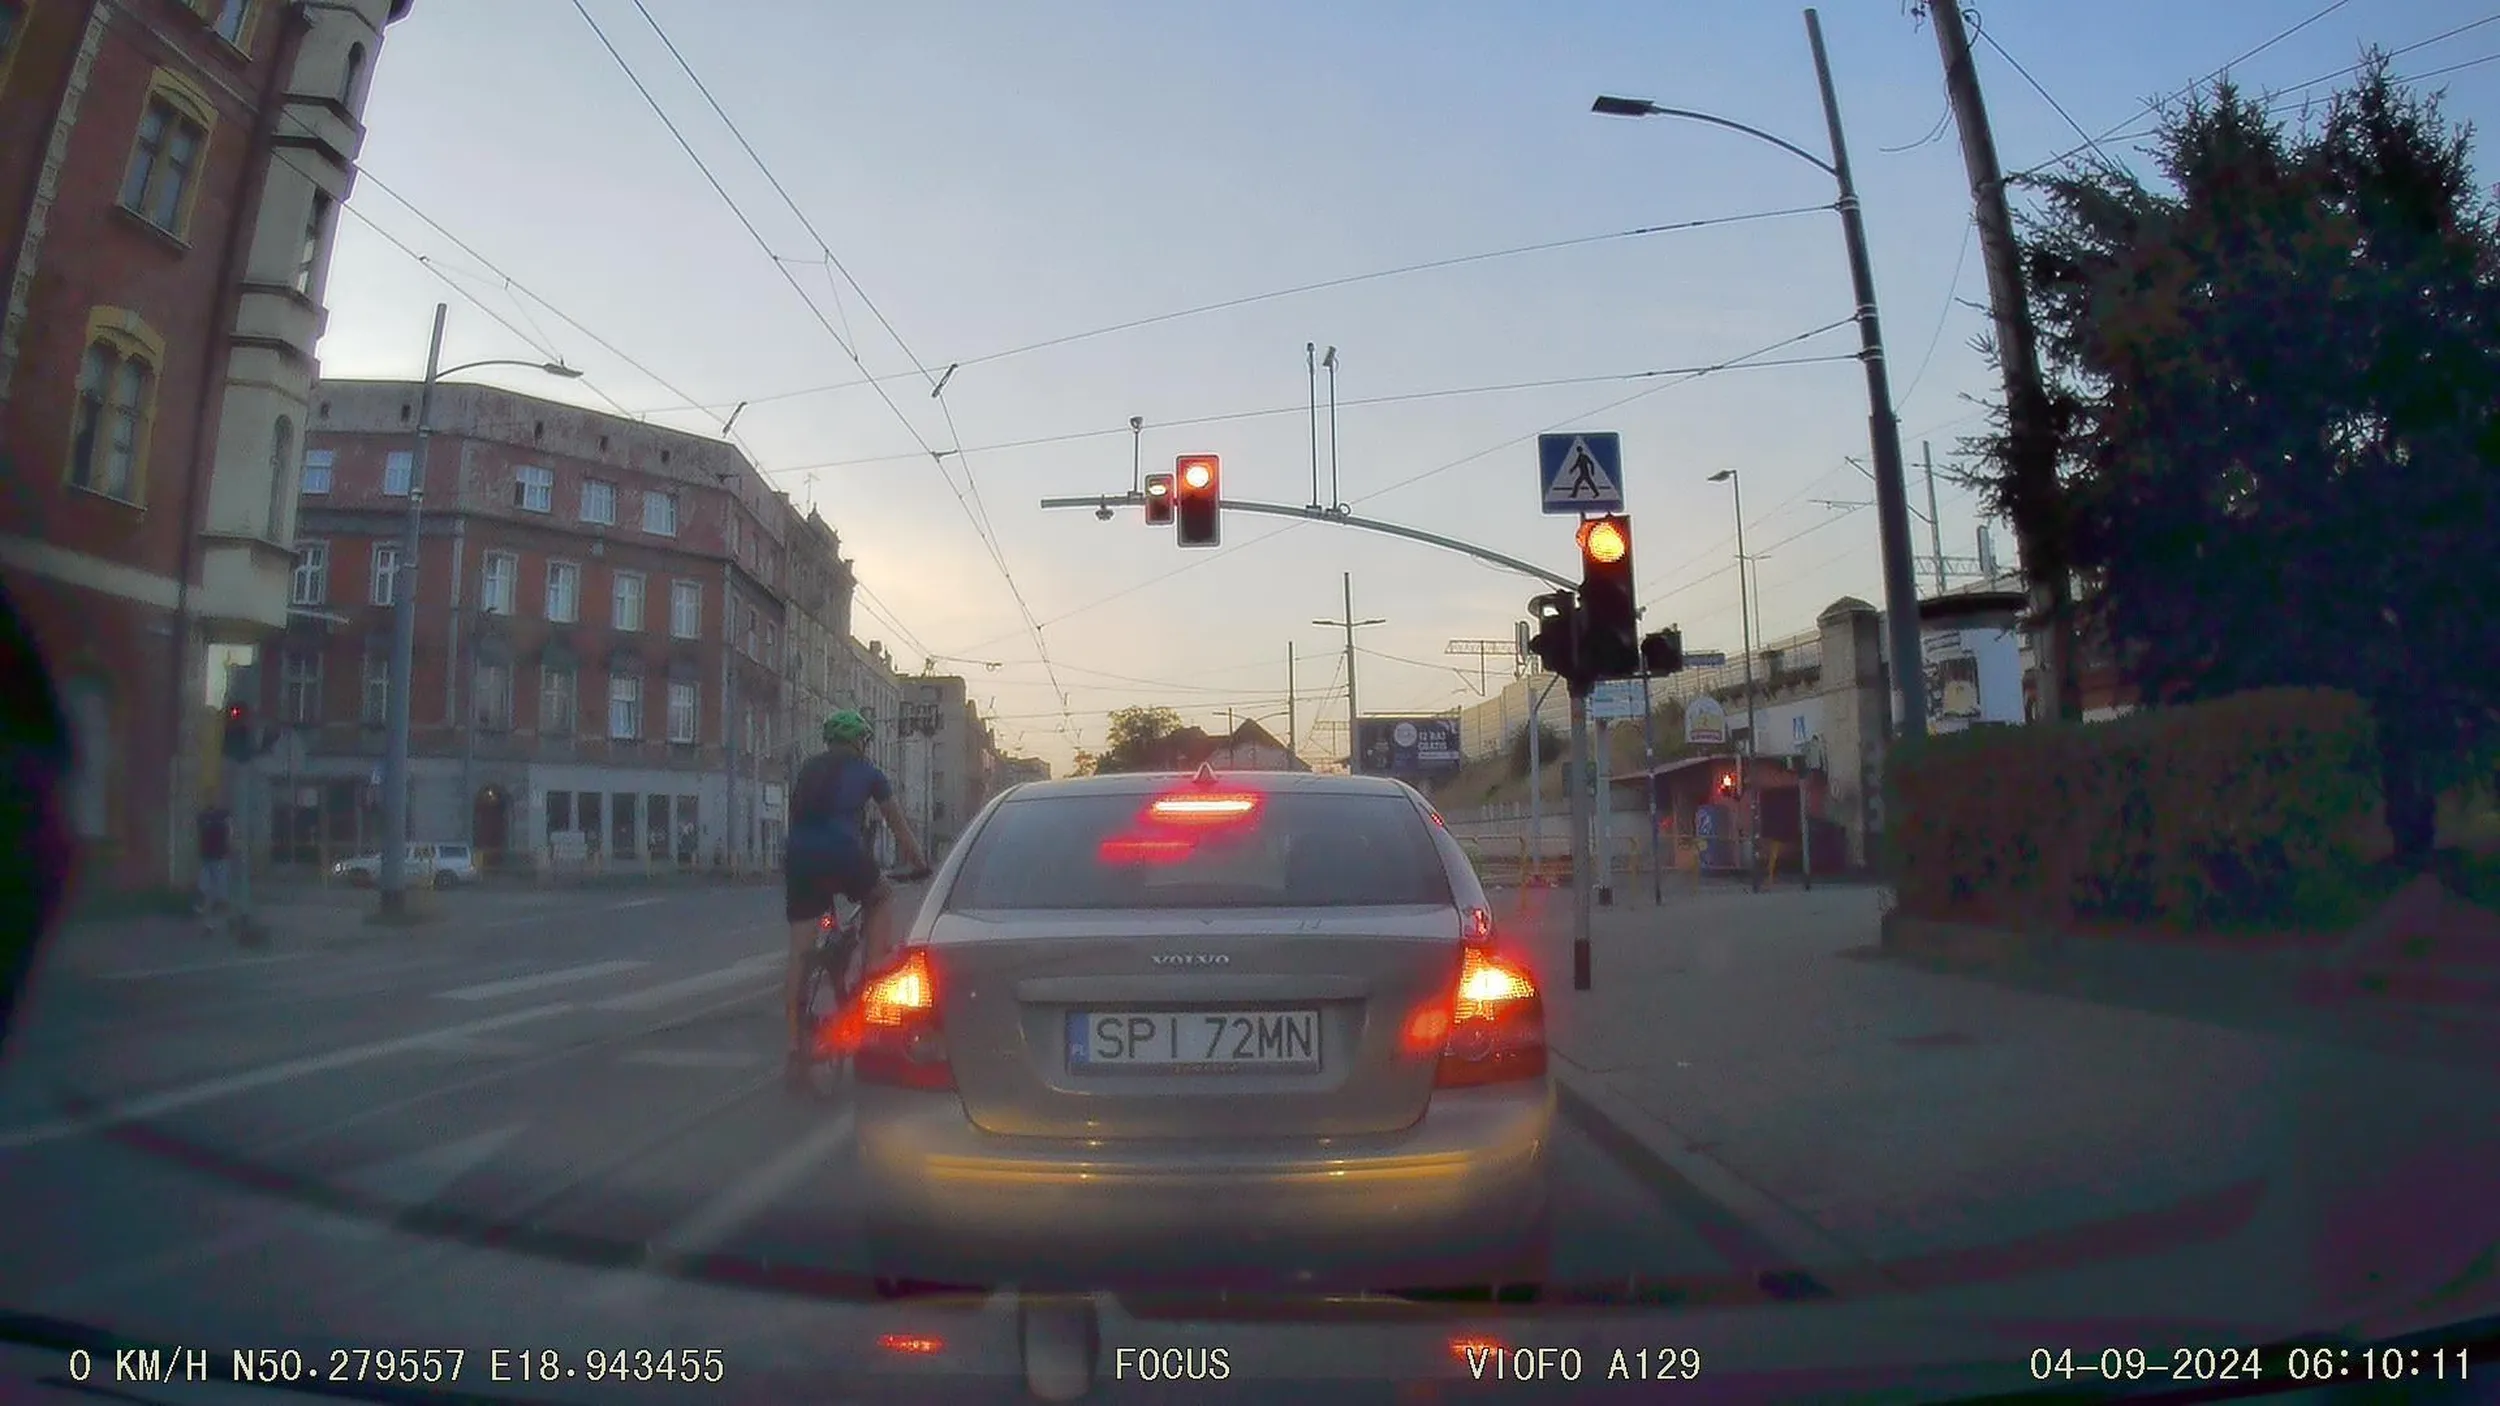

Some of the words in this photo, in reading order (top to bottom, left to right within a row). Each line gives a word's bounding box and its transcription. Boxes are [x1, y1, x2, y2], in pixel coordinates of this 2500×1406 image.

[1151, 953, 1231, 966] VOLVO
[1096, 1016, 1178, 1059] SPI
[1205, 1015, 1312, 1059] 72MN
